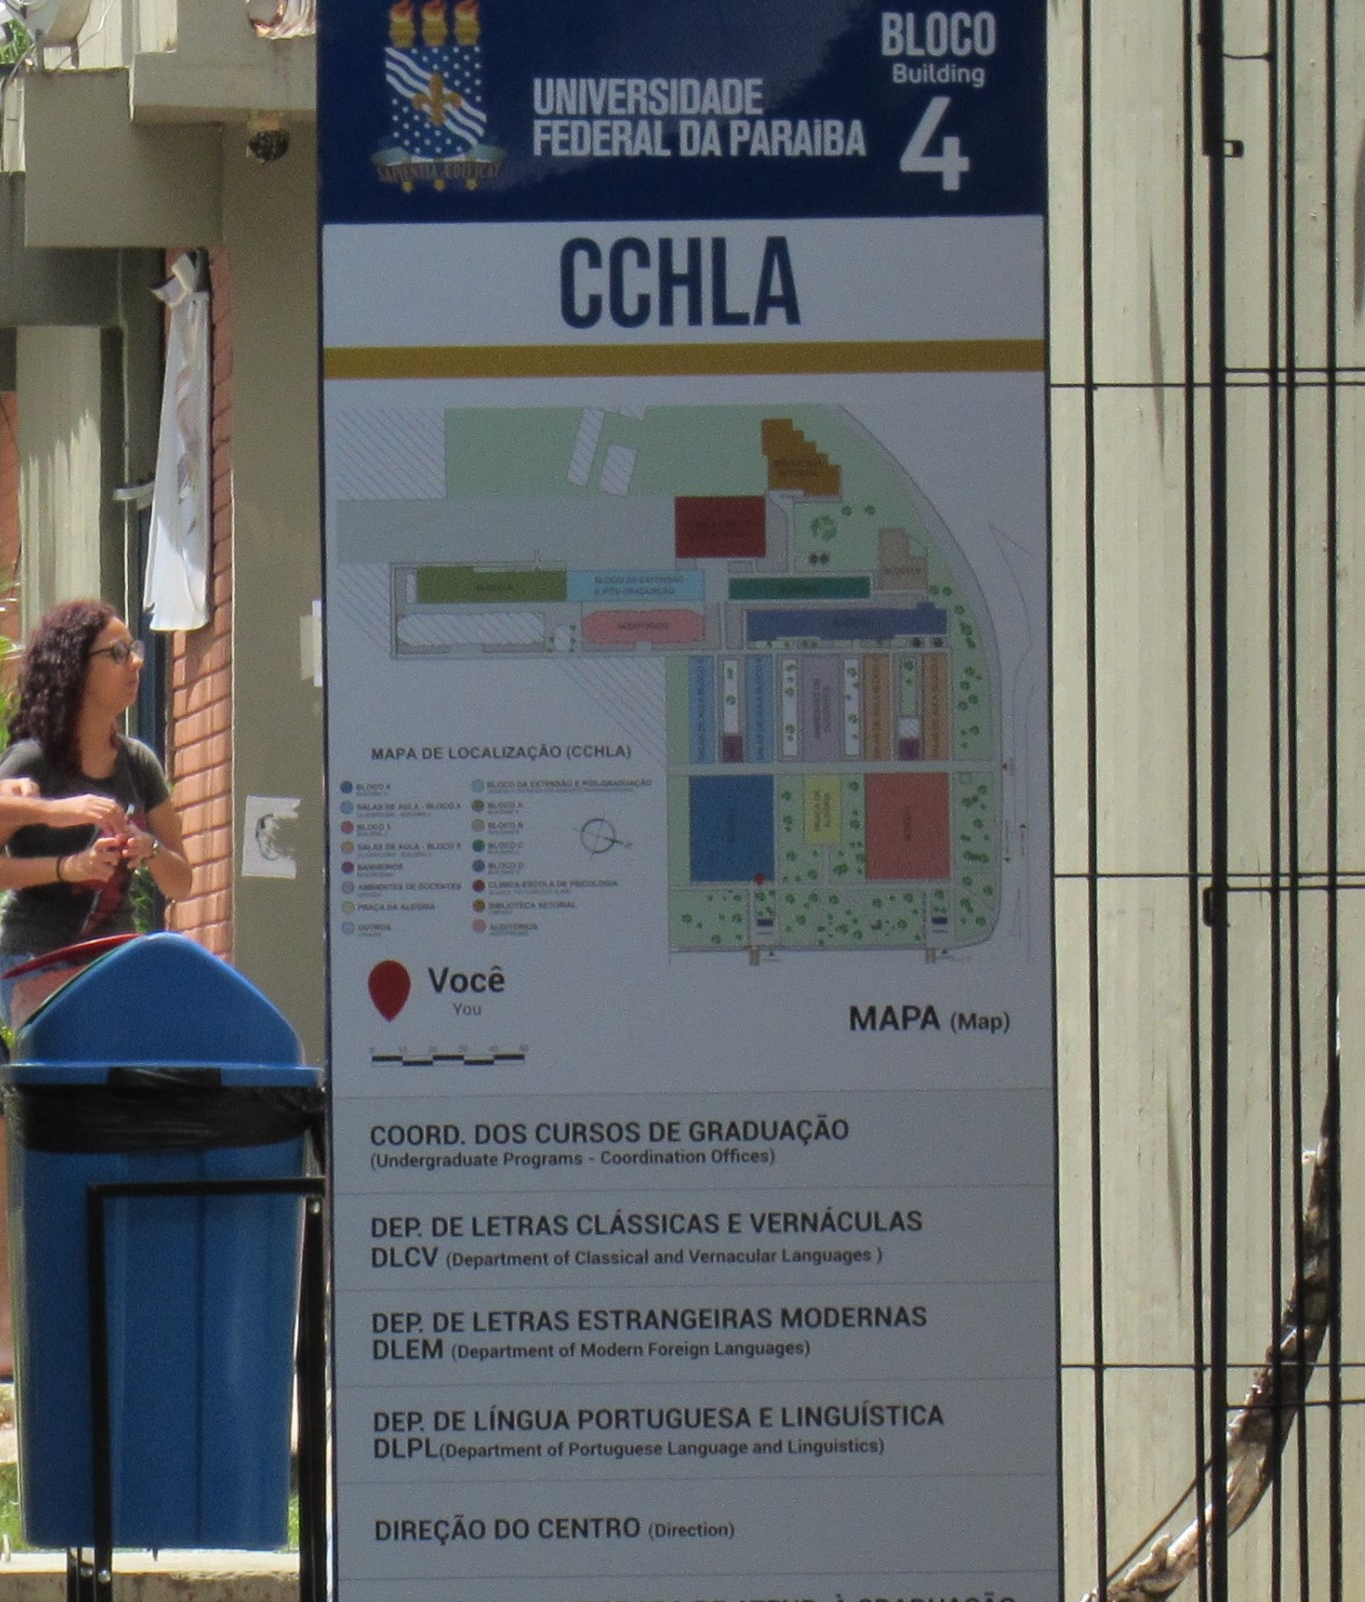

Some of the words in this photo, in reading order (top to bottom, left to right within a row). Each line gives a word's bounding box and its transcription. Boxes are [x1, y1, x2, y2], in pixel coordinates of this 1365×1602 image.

[881, 11, 997, 57] BLOCO
[892, 62, 986, 88] Building
[533, 77, 764, 116] UNIVERSIDADE
[532, 119, 672, 157] FEDERAL
[678, 119, 723, 157] DA
[899, 96, 970, 191] 4
[559, 235, 802, 330] CCHLA
[370, 747, 419, 761] MAPA
[420, 746, 444, 760] DE
[447, 743, 563, 762] LOCALIZAÇÃO
[565, 744, 633, 761] (CCHLA)
[427, 965, 506, 994] Você
[451, 1002, 483, 1017] You
[848, 1004, 942, 1032] MAPA
[949, 1011, 1011, 1035] (Map)
[369, 1124, 467, 1147] COORD.
[474, 1123, 528, 1145] DOS
[534, 1121, 642, 1145] CURSOS
[648, 1121, 682, 1143] DE
[688, 1113, 850, 1145] GRADUAÇÃO
[370, 1151, 499, 1172] (Undergraduate
[502, 1151, 584, 1170] Programs
[600, 1148, 707, 1166] Coordination
[710, 1147, 777, 1166] Offices)
[370, 1216, 423, 1239] DEP.
[431, 1216, 464, 1238] DE
[471, 1214, 569, 1237] LETRAS
[575, 1208, 721, 1236] CLÁSSICAS
[727, 1212, 743, 1235] E
[748, 1205, 923, 1234] VERNÁCULAS
[370, 1246, 439, 1269] DLCV
[445, 1250, 550, 1271] (Department
[552, 1249, 571, 1266] of
[574, 1248, 650, 1266] Classical
[653, 1248, 685, 1265] and
[688, 1248, 778, 1264] Vernacular
[371, 1312, 424, 1334] DEP.
[432, 1311, 465, 1334] DE
[472, 1309, 571, 1333] LETRAS
[577, 1307, 773, 1332] ESTRANGEIRAS
[780, 1305, 928, 1329] MODERNAS
[372, 1338, 444, 1361] DLEM
[450, 1344, 555, 1362] (Department
[558, 1341, 577, 1358] of
[580, 1341, 645, 1358] Modern
[647, 1340, 711, 1361] Foreign
[714, 1339, 811, 1360] Languages)
[373, 1410, 425, 1433] DEP.
[433, 1410, 467, 1432] DE
[473, 1404, 571, 1432] LÍNGUA
[577, 1406, 753, 1430] PORTUGUESA
[758, 1406, 774, 1428] E
[780, 1399, 945, 1428] LINGUÍSTICA
[546, 1441, 565, 1458] of
[568, 1441, 664, 1460] Portuguese
[666, 1441, 749, 1460] Language
[751, 1438, 784, 1455] and
[786, 1437, 886, 1458] Linguistics)
[374, 1513, 487, 1547] DIREÇÃO
[493, 1518, 531, 1541] DO
[537, 1516, 642, 1540] CENTRO
[647, 1521, 736, 1541] (Direction)
